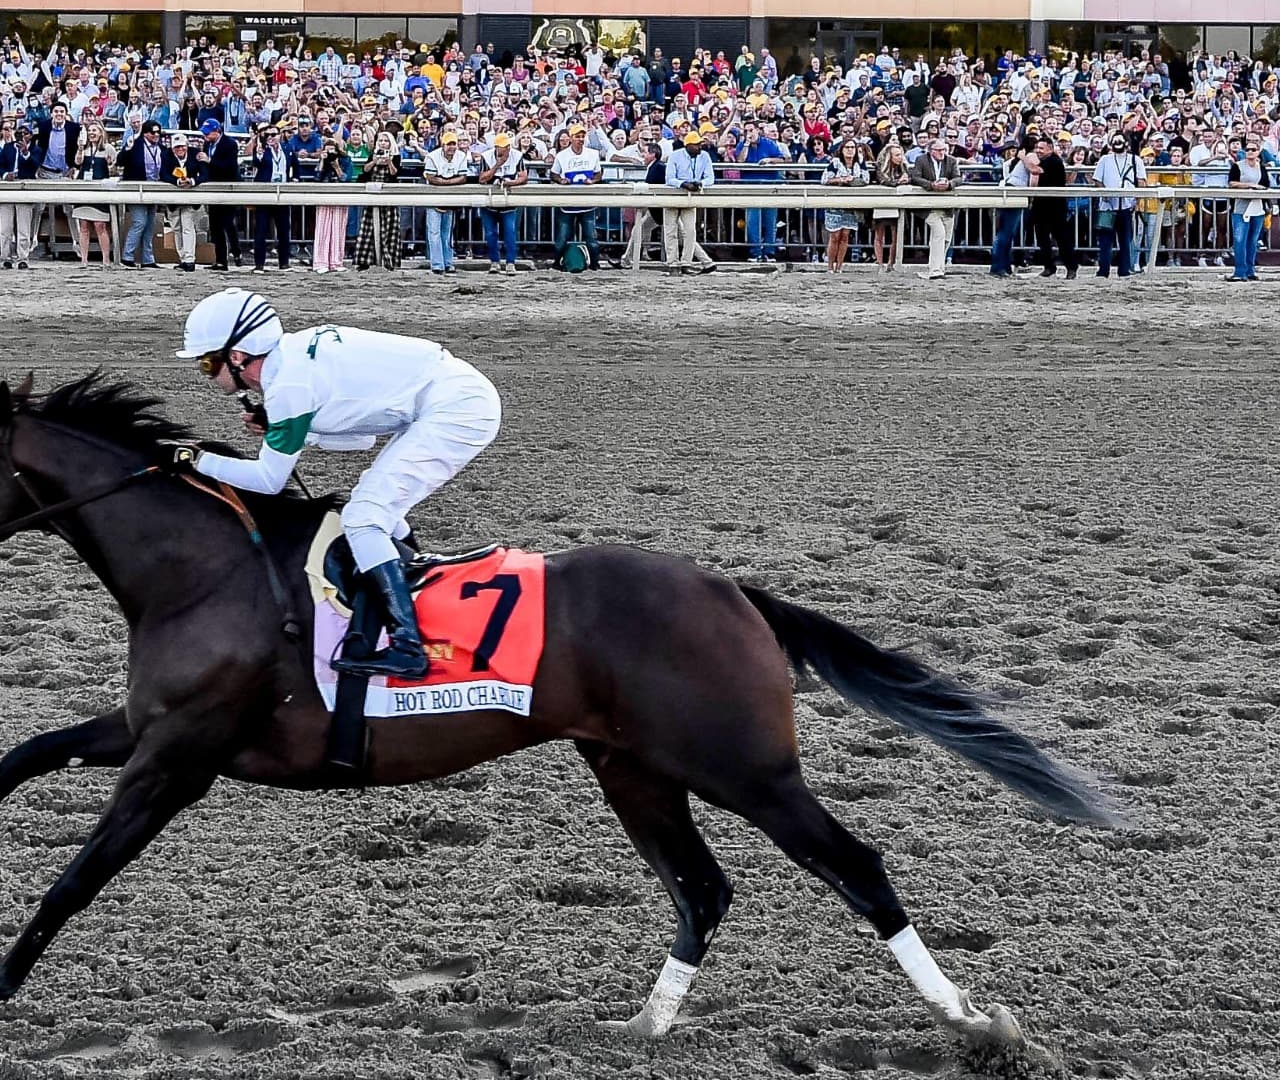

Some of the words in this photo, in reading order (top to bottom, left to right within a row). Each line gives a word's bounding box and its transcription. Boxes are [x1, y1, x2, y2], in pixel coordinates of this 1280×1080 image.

[460, 574, 522, 672] 7
[394, 691, 426, 712] HOT
[430, 688, 463, 710] ROD
